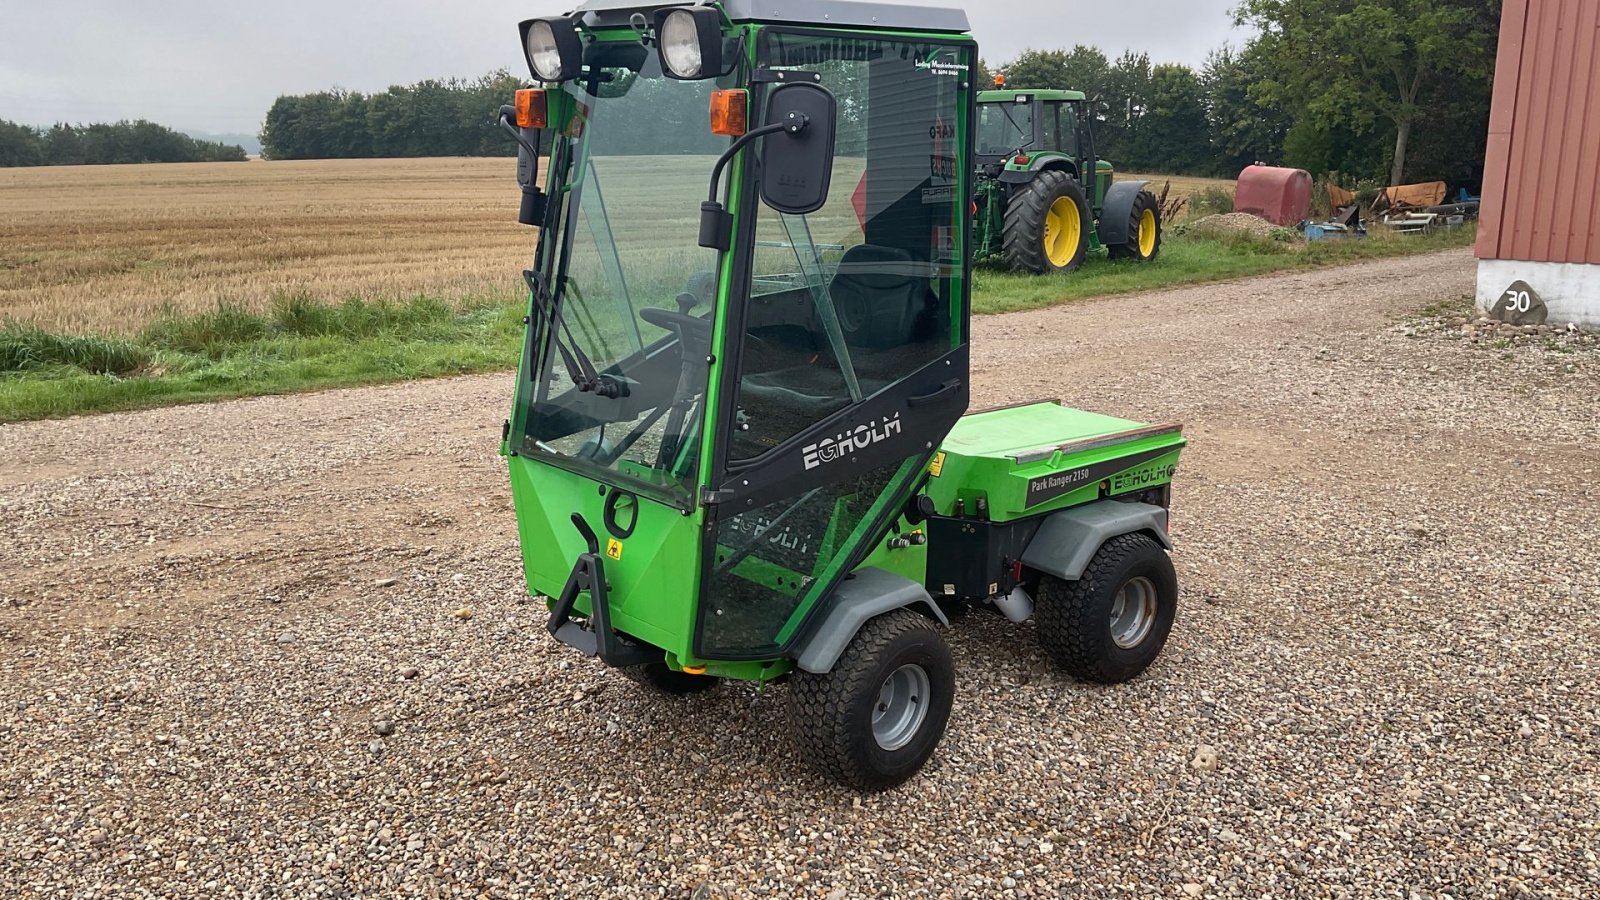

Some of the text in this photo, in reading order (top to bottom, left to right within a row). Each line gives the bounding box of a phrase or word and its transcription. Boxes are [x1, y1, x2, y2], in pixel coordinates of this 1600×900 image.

[1505, 290, 1530, 313] 30
[802, 411, 901, 470] EGHOLM
[1031, 469, 1089, 492] Park Ranger 2150
[1114, 466, 1166, 490] EGHOLM
